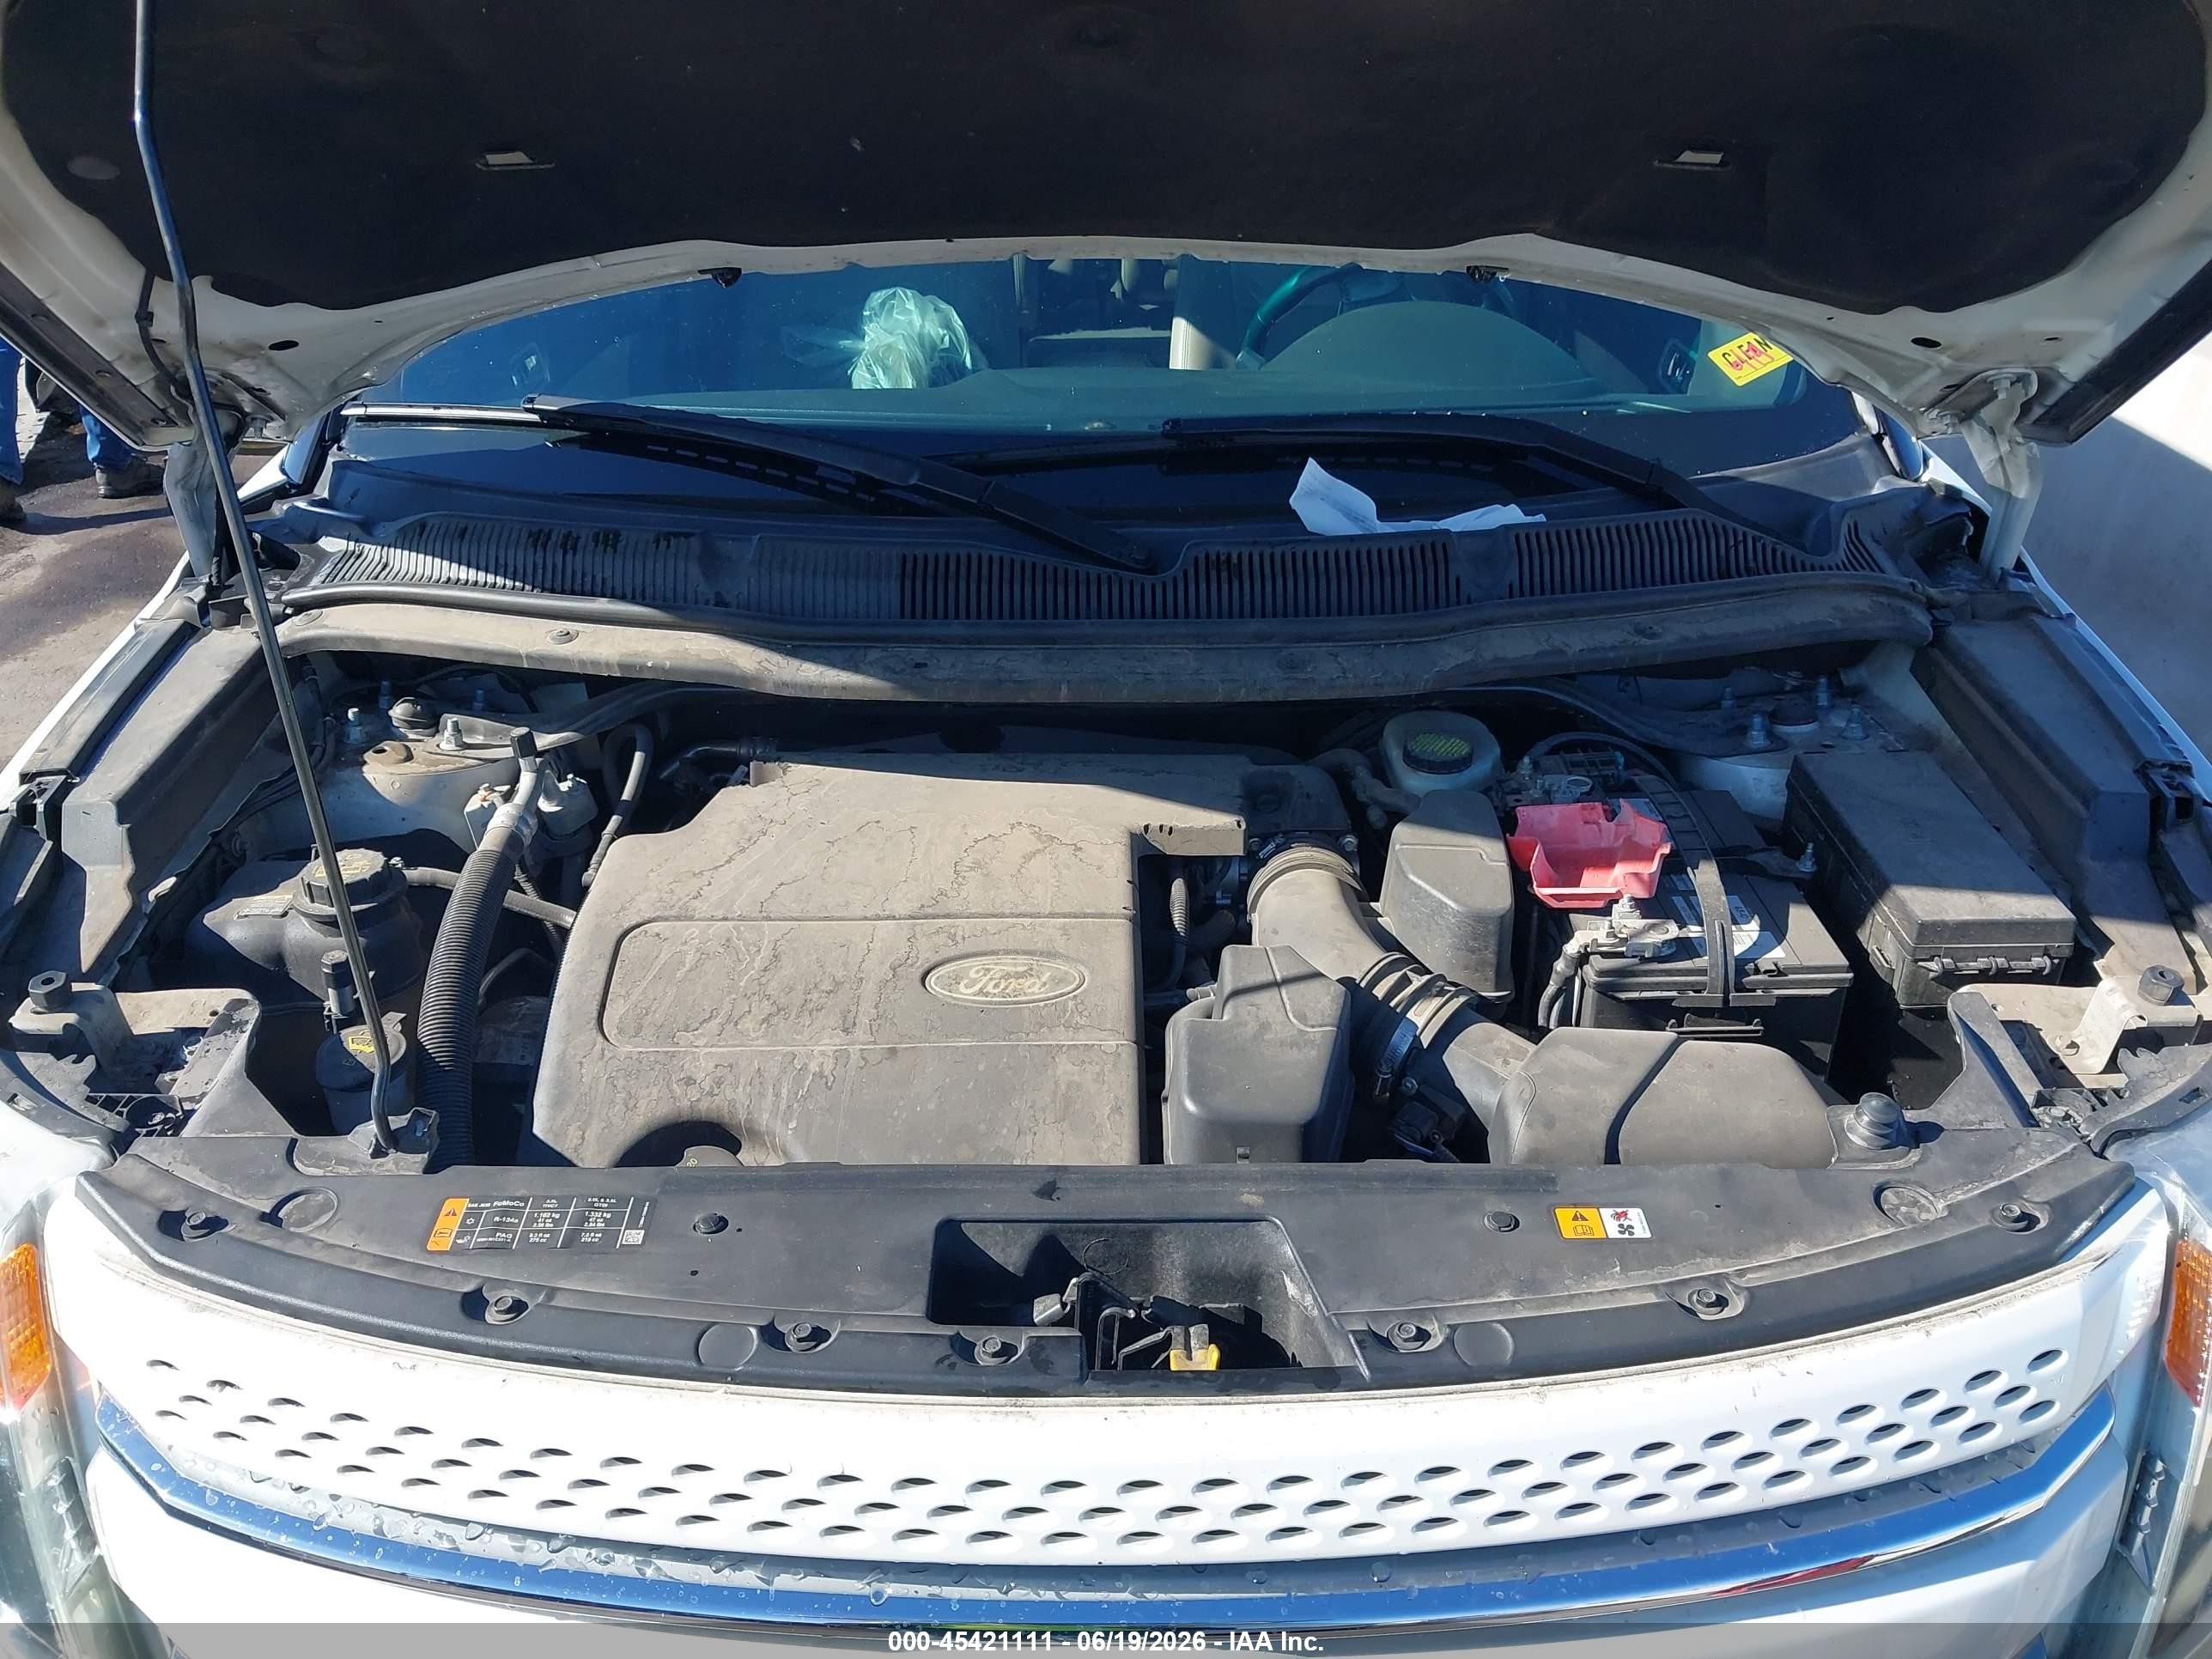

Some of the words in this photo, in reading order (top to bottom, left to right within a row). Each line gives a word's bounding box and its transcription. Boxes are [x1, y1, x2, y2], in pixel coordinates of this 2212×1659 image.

[1721, 336, 1773, 370] CLEAN
[958, 964, 1052, 994] Ford
[492, 1200, 526, 1208] FoMoCo
